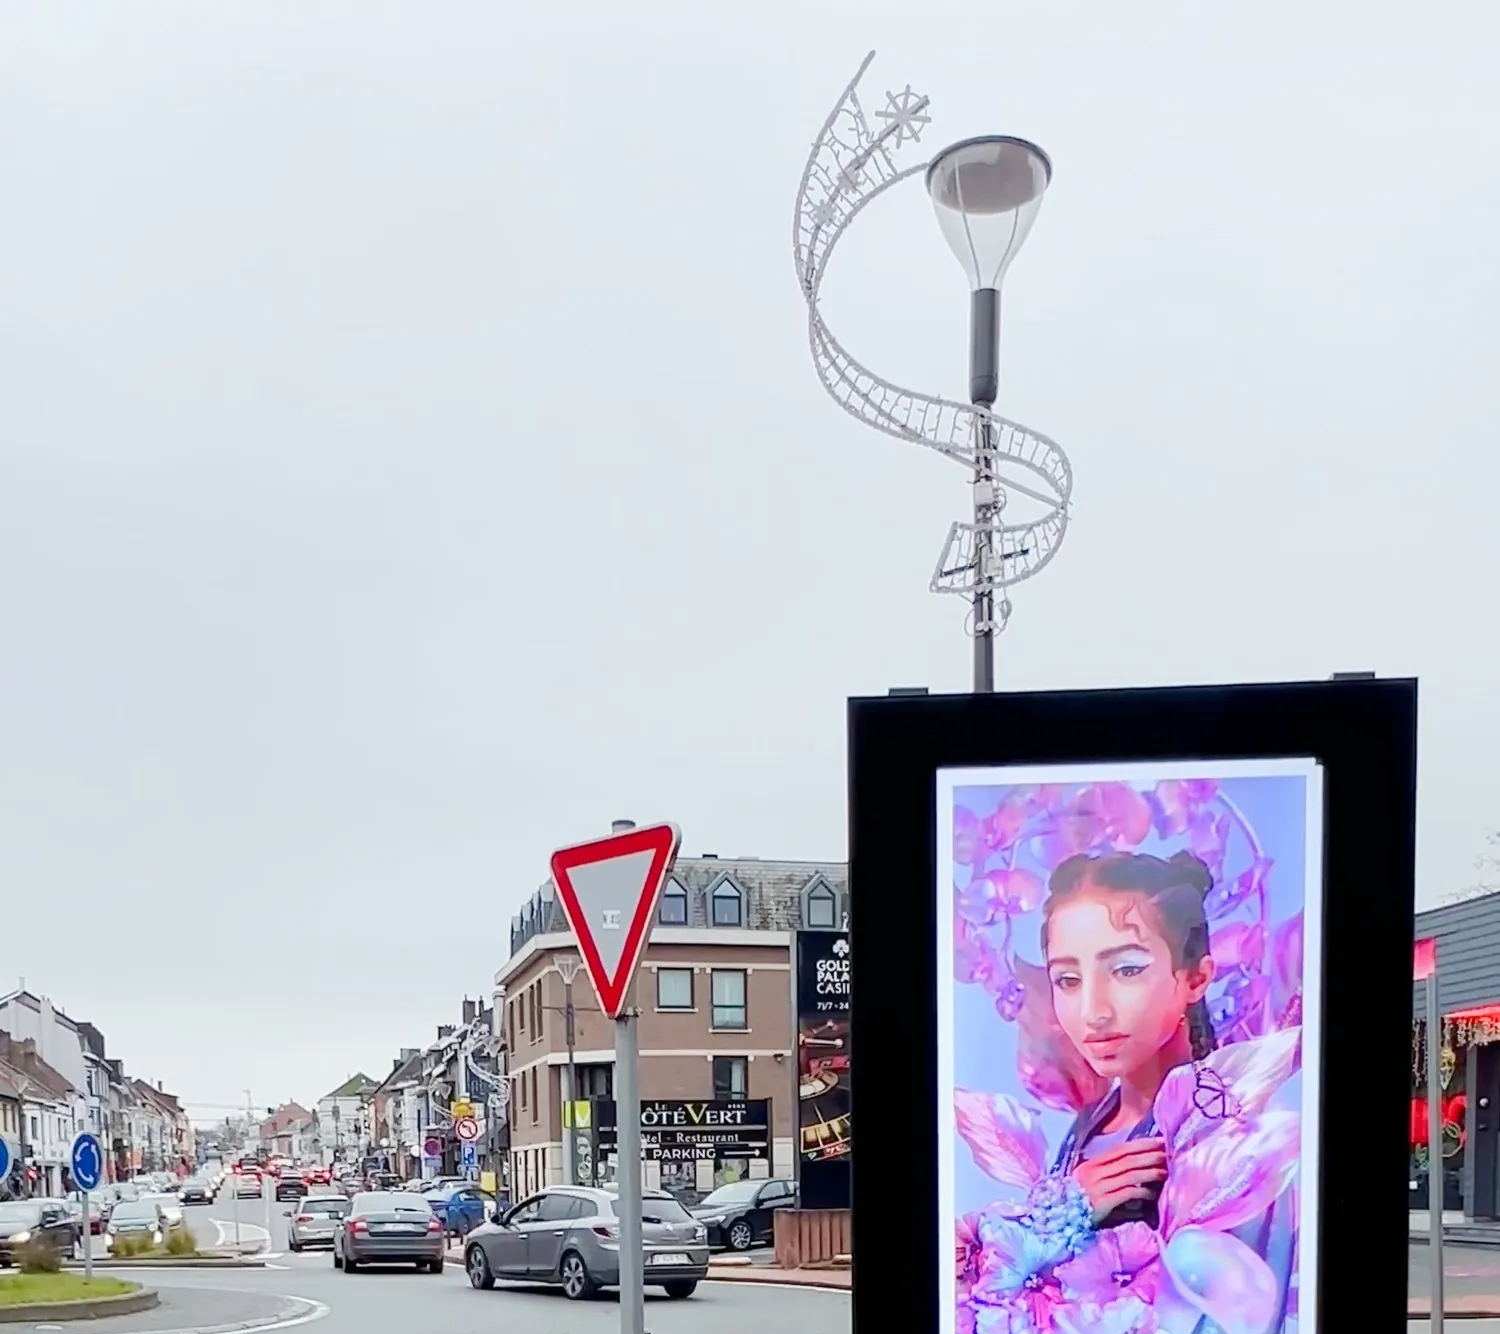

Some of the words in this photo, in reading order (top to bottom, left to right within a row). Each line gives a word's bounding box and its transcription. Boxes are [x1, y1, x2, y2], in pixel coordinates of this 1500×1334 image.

[816, 960, 850, 972] GOLD
[816, 971, 850, 982] PALA
[816, 983, 850, 994] CASI
[641, 1103, 747, 1125] ÔTÉVERT
[676, 1132, 739, 1143] Restaurant
[653, 1148, 716, 1159] PARKING
